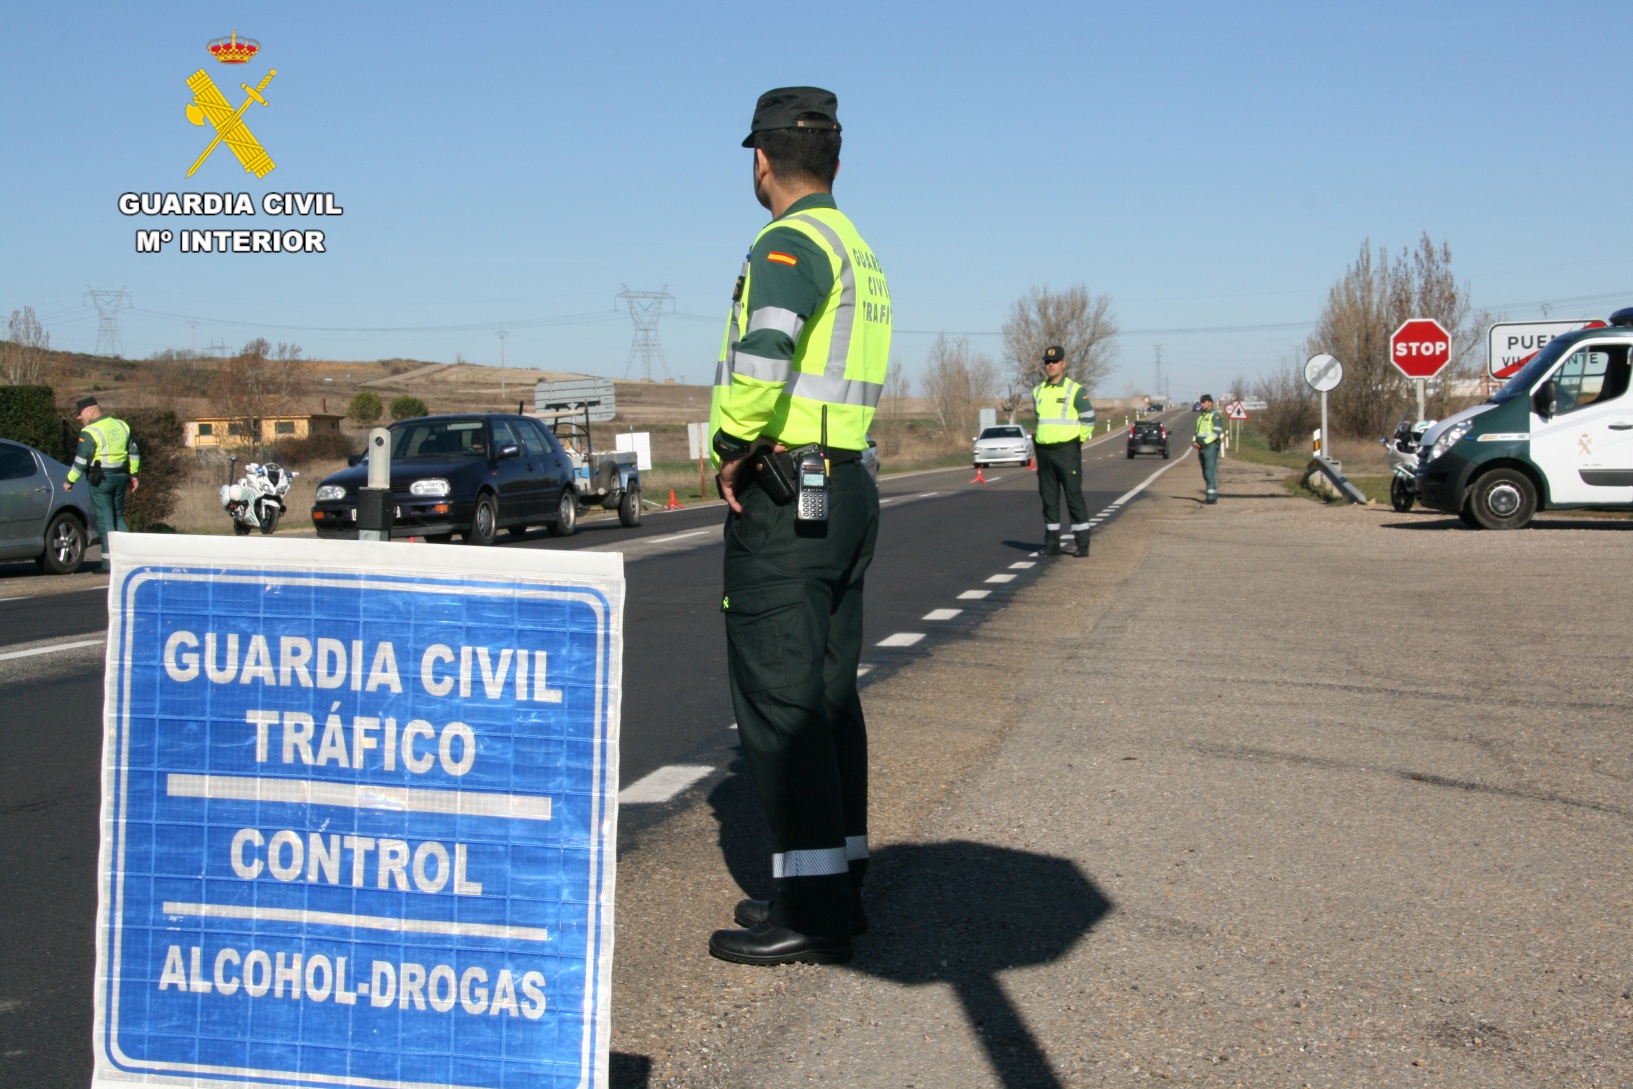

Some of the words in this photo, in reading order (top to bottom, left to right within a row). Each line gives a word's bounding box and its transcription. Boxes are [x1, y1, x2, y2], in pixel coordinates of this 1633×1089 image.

[863, 300, 892, 325] TRAFI
[868, 275, 891, 299] CIVI
[1395, 341, 1447, 357] STOP
[164, 631, 402, 694] GUARDIA
[421, 643, 562, 703] CIVIL
[246, 701, 476, 777] TRÁFICO
[230, 828, 483, 896] CONTROL
[158, 944, 547, 1020] ALCOHOL-DROGAS
